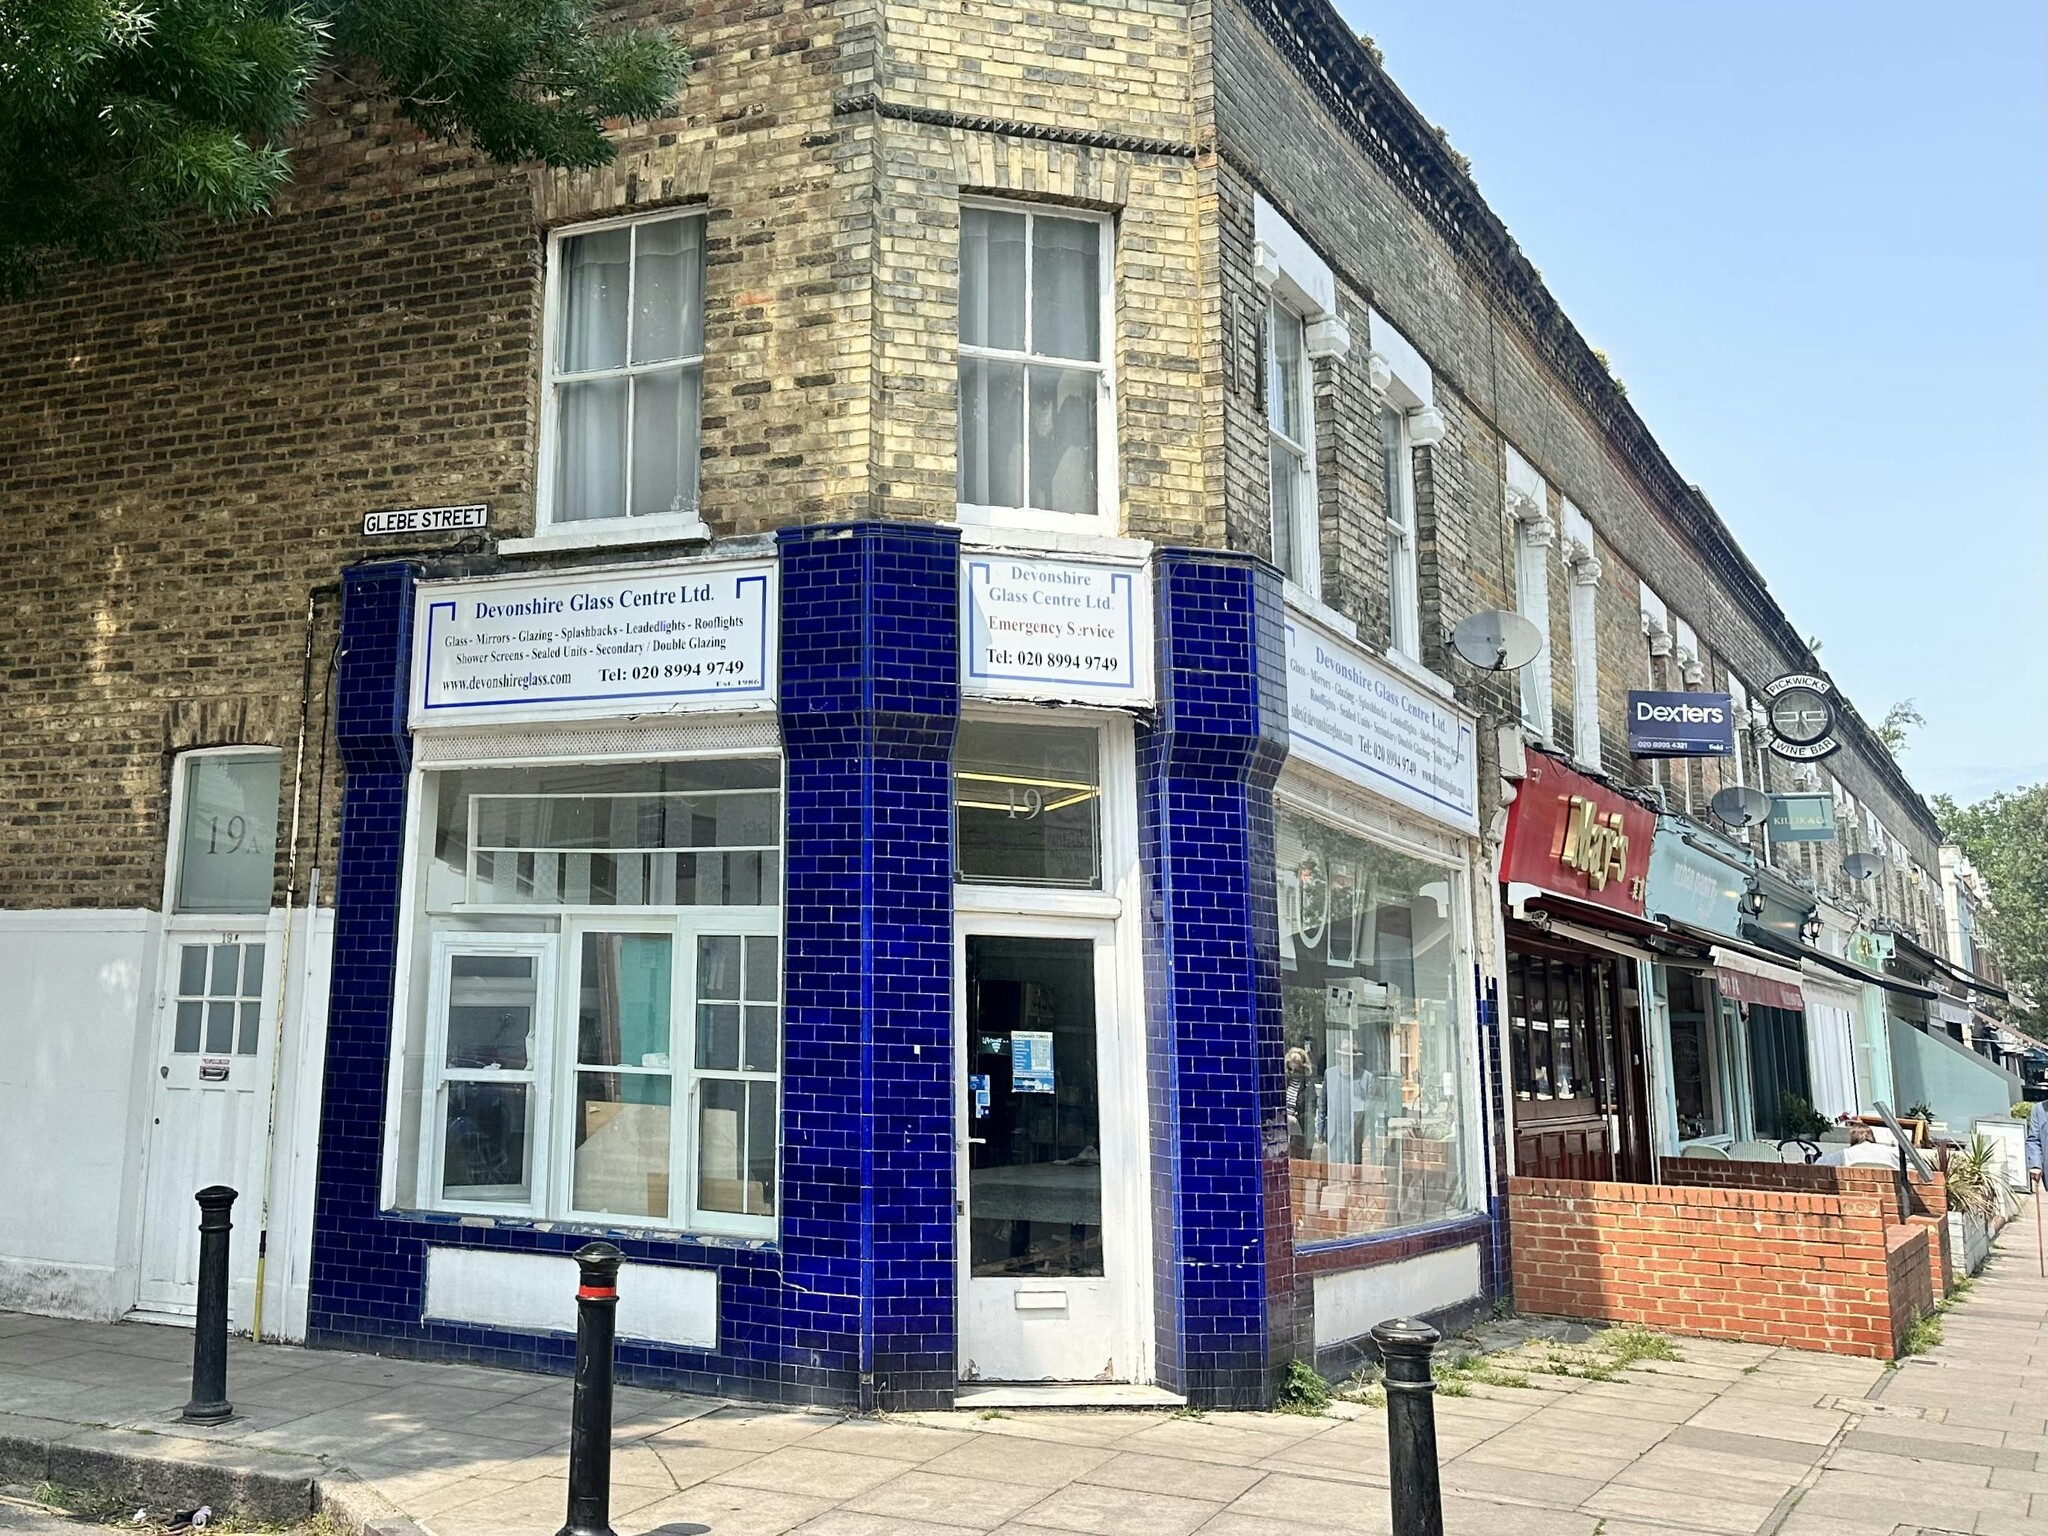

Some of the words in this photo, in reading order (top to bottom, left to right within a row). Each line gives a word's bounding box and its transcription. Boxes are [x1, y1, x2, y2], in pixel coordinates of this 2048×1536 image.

[366, 512, 418, 532] GLEBE
[421, 508, 485, 528] STREET
[1011, 566, 1091, 586] Devonshire
[475, 597, 564, 619] Devonshire
[570, 594, 614, 611] Glass
[619, 589, 676, 608] Centre
[681, 584, 715, 603] Ltd.
[989, 587, 1028, 603] Glass
[1032, 590, 1081, 608] Centre
[1086, 594, 1115, 610] Ltd.
[444, 635, 468, 648] Glass
[476, 633, 510, 646] Mirrors
[518, 629, 553, 643] Glazing
[561, 624, 618, 642] Splashbacks
[626, 620, 686, 635] Leadedlights
[695, 615, 744, 631] Rooflights
[988, 615, 1063, 638] Emergency
[456, 653, 489, 665] Shower
[490, 650, 524, 663] Screens
[531, 647, 561, 660] Sealed
[563, 645, 587, 658] Units
[596, 642, 644, 656] Secondary
[653, 637, 687, 651] Double
[689, 636, 726, 650] Glazing
[986, 648, 1013, 664] Tel:
[1017, 651, 1043, 667] 020
[1047, 653, 1081, 669] 8994
[1085, 655, 1118, 672] 9749
[442, 672, 572, 691] www.devonshireglass.com
[598, 668, 627, 682] Tel:
[632, 665, 659, 680] 020
[664, 663, 701, 678] 8994
[706, 660, 744, 676] 9749
[1315, 645, 1374, 692] Devonshire
[1374, 680, 1399, 707] Glass
[1401, 695, 1430, 724] Centre
[1432, 711, 1447, 734] Ltd.
[1768, 674, 1829, 695] PICKWICKS
[1637, 702, 1724, 723] Dexters
[1359, 735, 1372, 757] Tel:
[1373, 741, 1386, 763] 020
[1386, 749, 1401, 769] 8994
[1401, 756, 1417, 778] 9749
[1776, 741, 1806, 756] WINE
[1810, 739, 1834, 756] BAR
[1007, 788, 1042, 820] 19
[206, 815, 260, 855] 19A
[1562, 795, 1629, 892] May's
